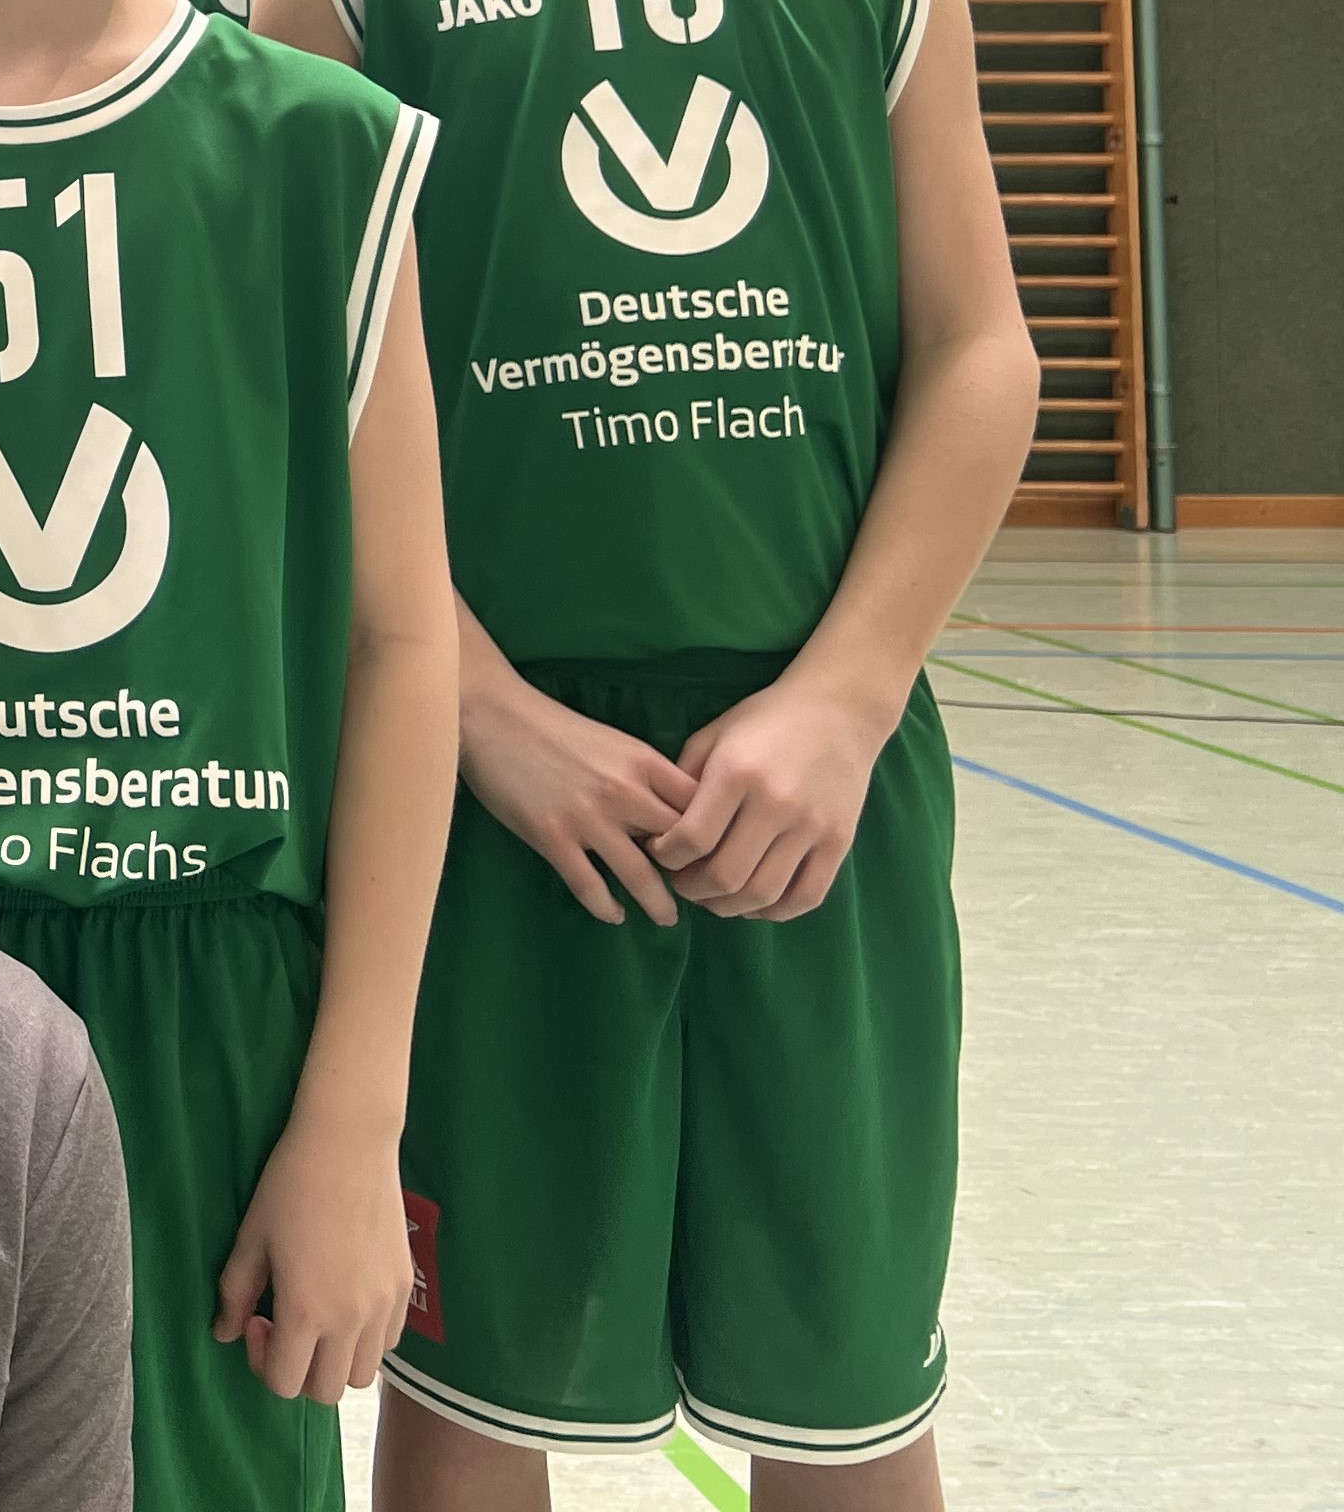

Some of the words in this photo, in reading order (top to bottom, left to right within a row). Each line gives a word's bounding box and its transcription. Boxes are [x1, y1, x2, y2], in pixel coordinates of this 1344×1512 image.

[578, 280, 790, 328] Deutsche
[561, 406, 680, 450] Timo
[689, 395, 806, 441] Flach
[48, 826, 208, 881] Flachs
